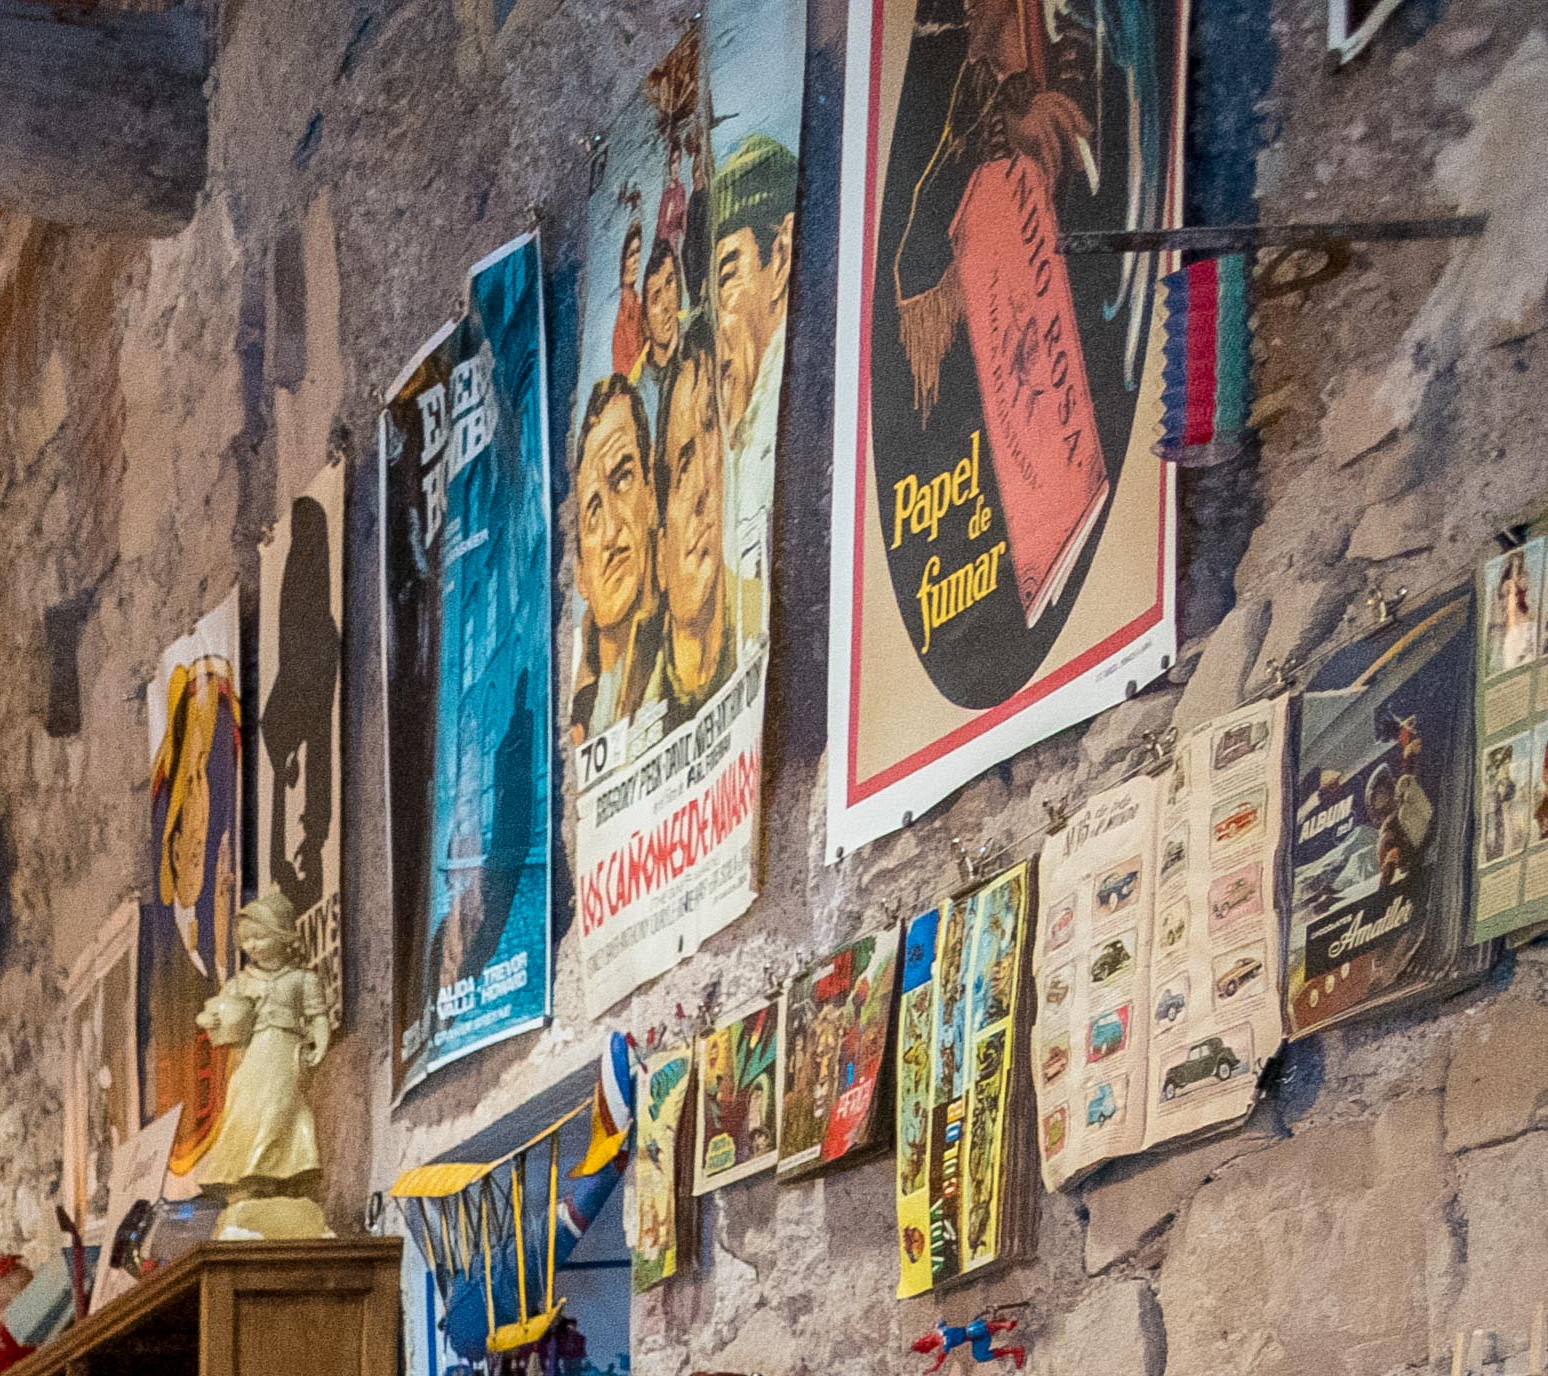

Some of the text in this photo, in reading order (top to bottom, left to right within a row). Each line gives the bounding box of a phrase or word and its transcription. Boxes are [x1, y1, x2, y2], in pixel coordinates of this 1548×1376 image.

[892, 431, 1006, 654] Papel de fumar
[580, 737, 607, 782] 70
[580, 861, 604, 937] LOS
[607, 805, 686, 917] CAÑONES
[685, 789, 709, 867] DE
[1299, 794, 1354, 844] ALBUM
